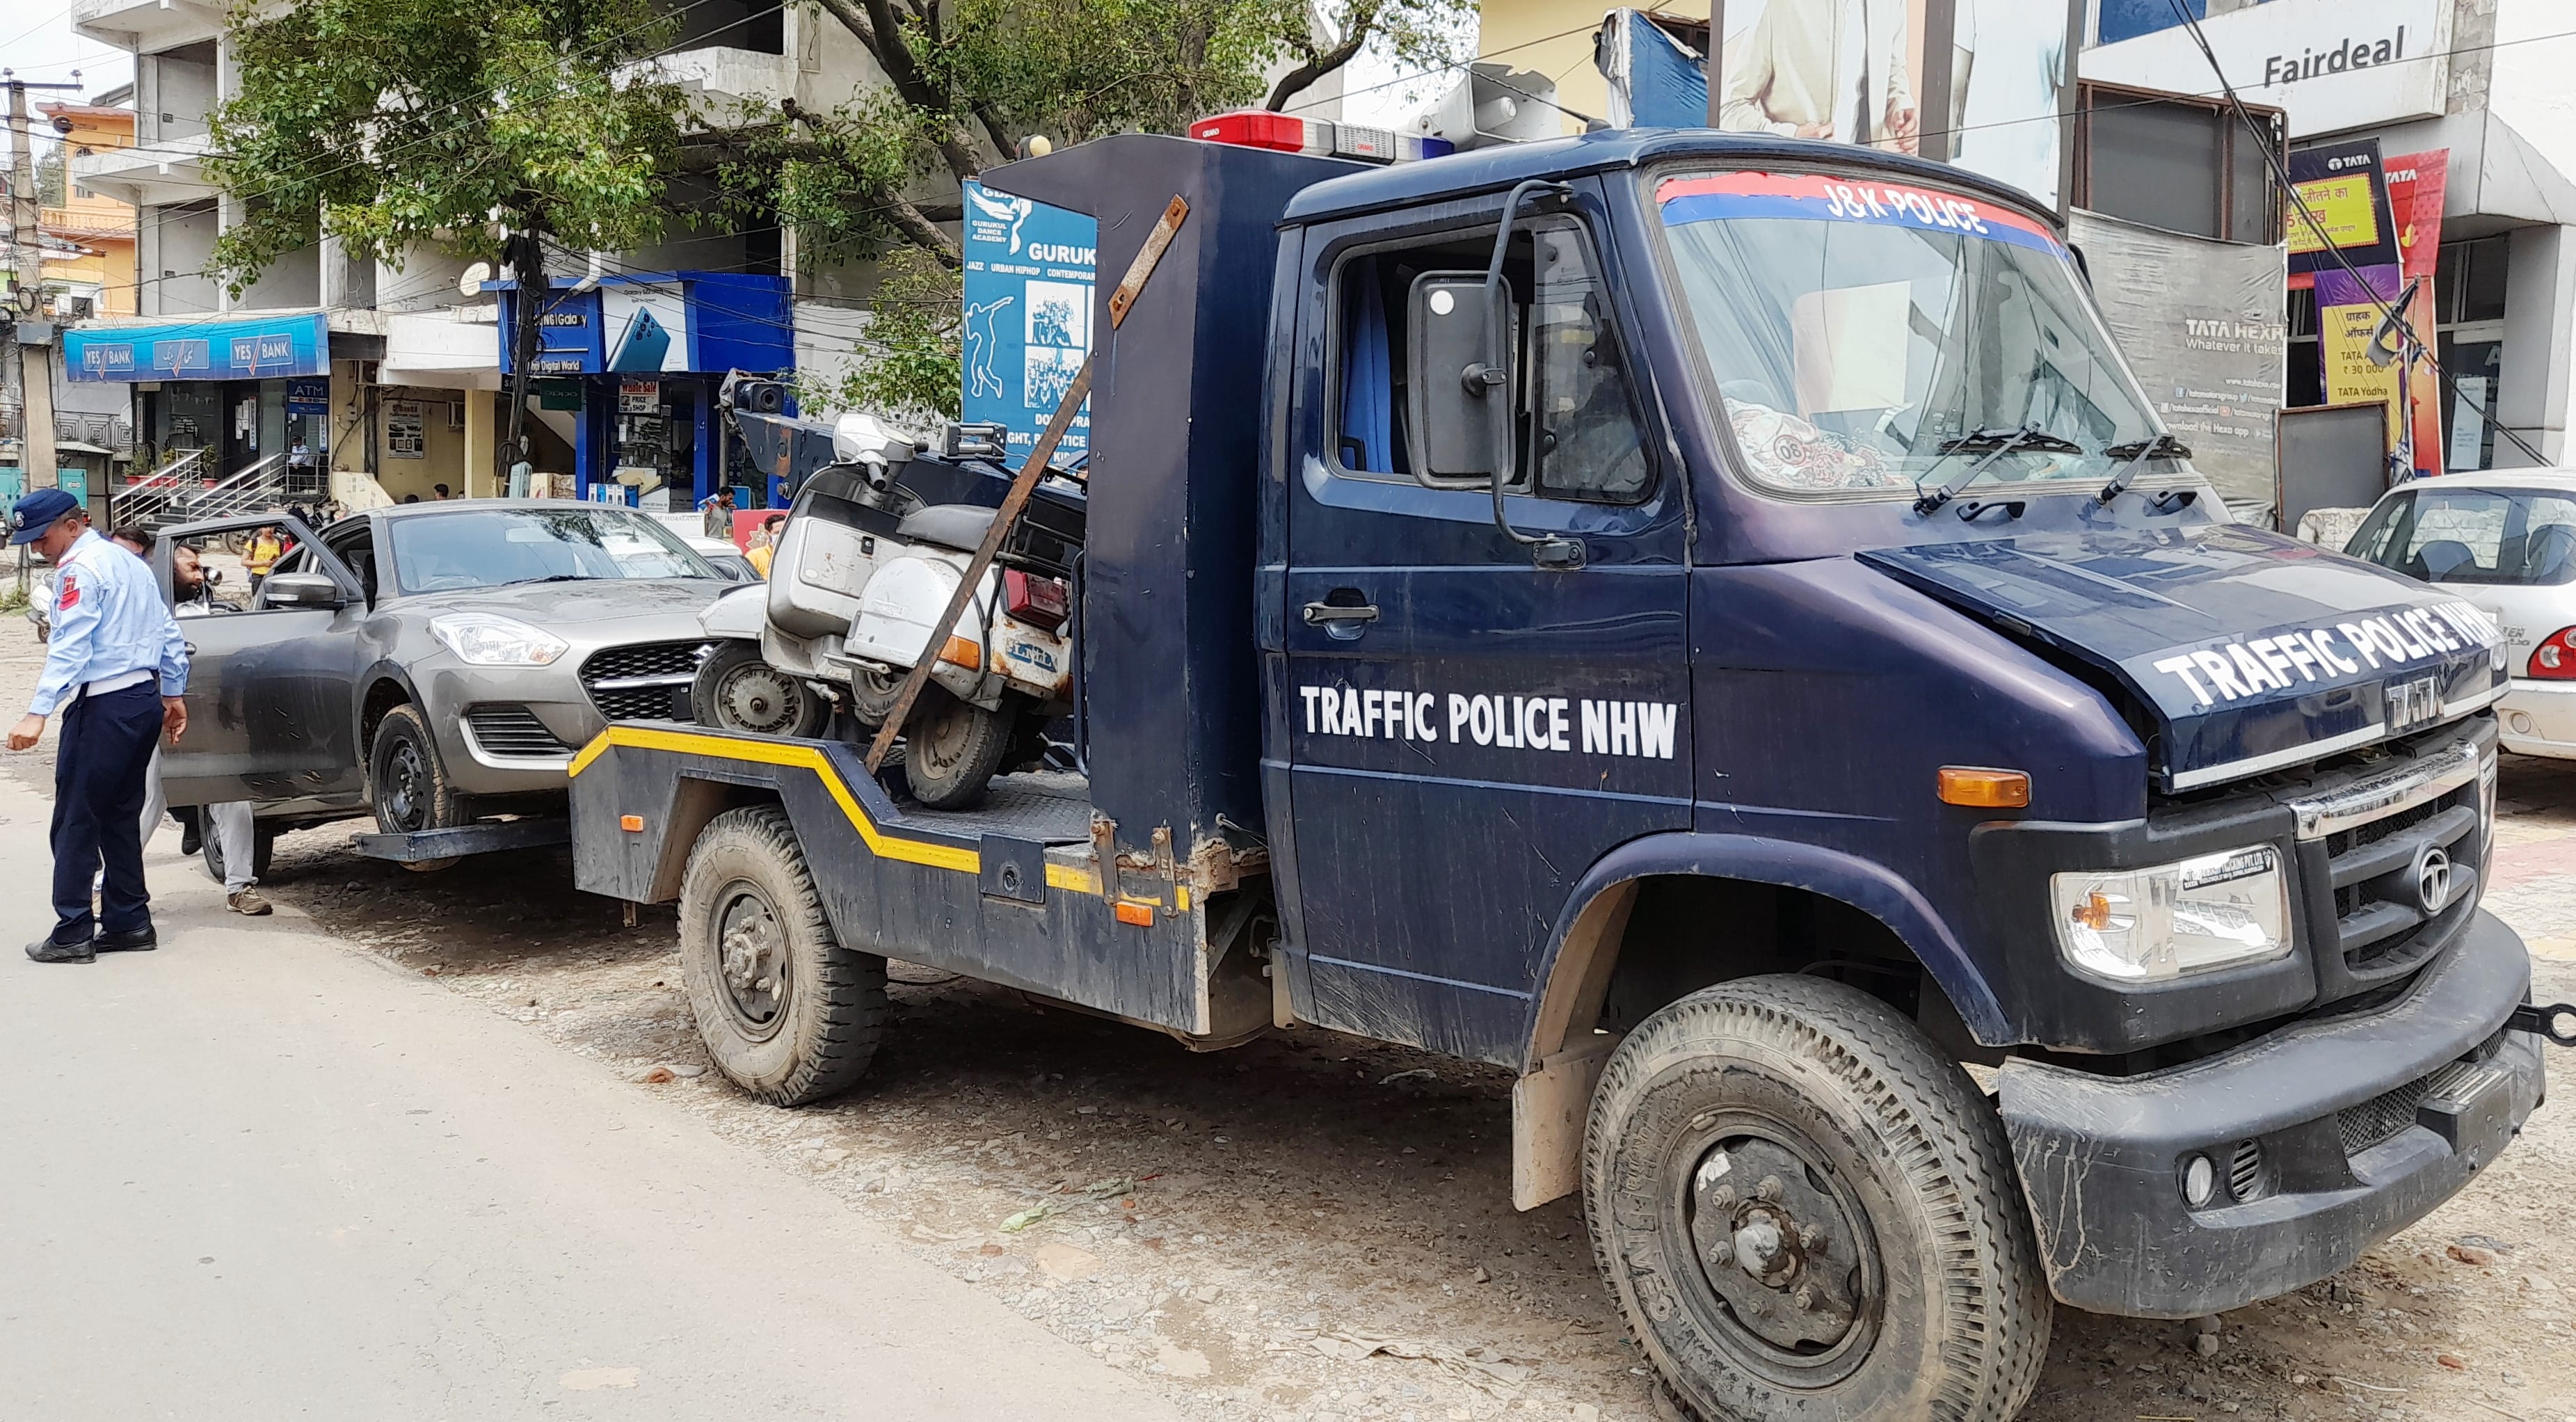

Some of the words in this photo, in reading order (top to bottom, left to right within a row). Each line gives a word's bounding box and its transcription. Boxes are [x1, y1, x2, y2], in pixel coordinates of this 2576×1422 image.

[2264, 25, 2404, 88] Fairdeal
[2343, 154, 2371, 168] TATA
[2385, 169, 2417, 184] TATA
[1823, 184, 1886, 219] J&K
[1884, 189, 1989, 234] POLICE
[972, 220, 1007, 230] GURUKUL
[972, 234, 1007, 243] ACADEMY
[1028, 242, 1096, 266] GURUK
[967, 261, 984, 271] JAZZ
[991, 263, 1014, 273] URBAN
[1015, 265, 1041, 275] HIPHOP
[559, 312, 587, 329] Galay
[2185, 319, 2231, 339] TATA
[234, 345, 251, 360] YES
[262, 342, 289, 358] BANK
[2185, 338, 2241, 353] Whatever
[2243, 342, 2251, 353] it
[2254, 342, 2283, 356] takes
[86, 350, 101, 365] YES
[109, 350, 131, 365] BANK
[2341, 351, 2363, 360] TATA
[541, 361, 561, 373] Digital
[561, 360, 579, 371] World
[295, 385, 323, 396] ATM
[2338, 388, 2360, 397] TATA
[2360, 387, 2388, 397] Yodha
[2213, 423, 2233, 434] Hexa
[2234, 427, 2250, 438] app
[2153, 630, 2359, 706] TRAFFIC
[2336, 606, 2457, 669] POLICE
[2385, 677, 2444, 729] TATA
[1299, 686, 1438, 742] TRAFFIC
[1448, 694, 1570, 752] POLICE
[1581, 699, 1677, 760] NHW
